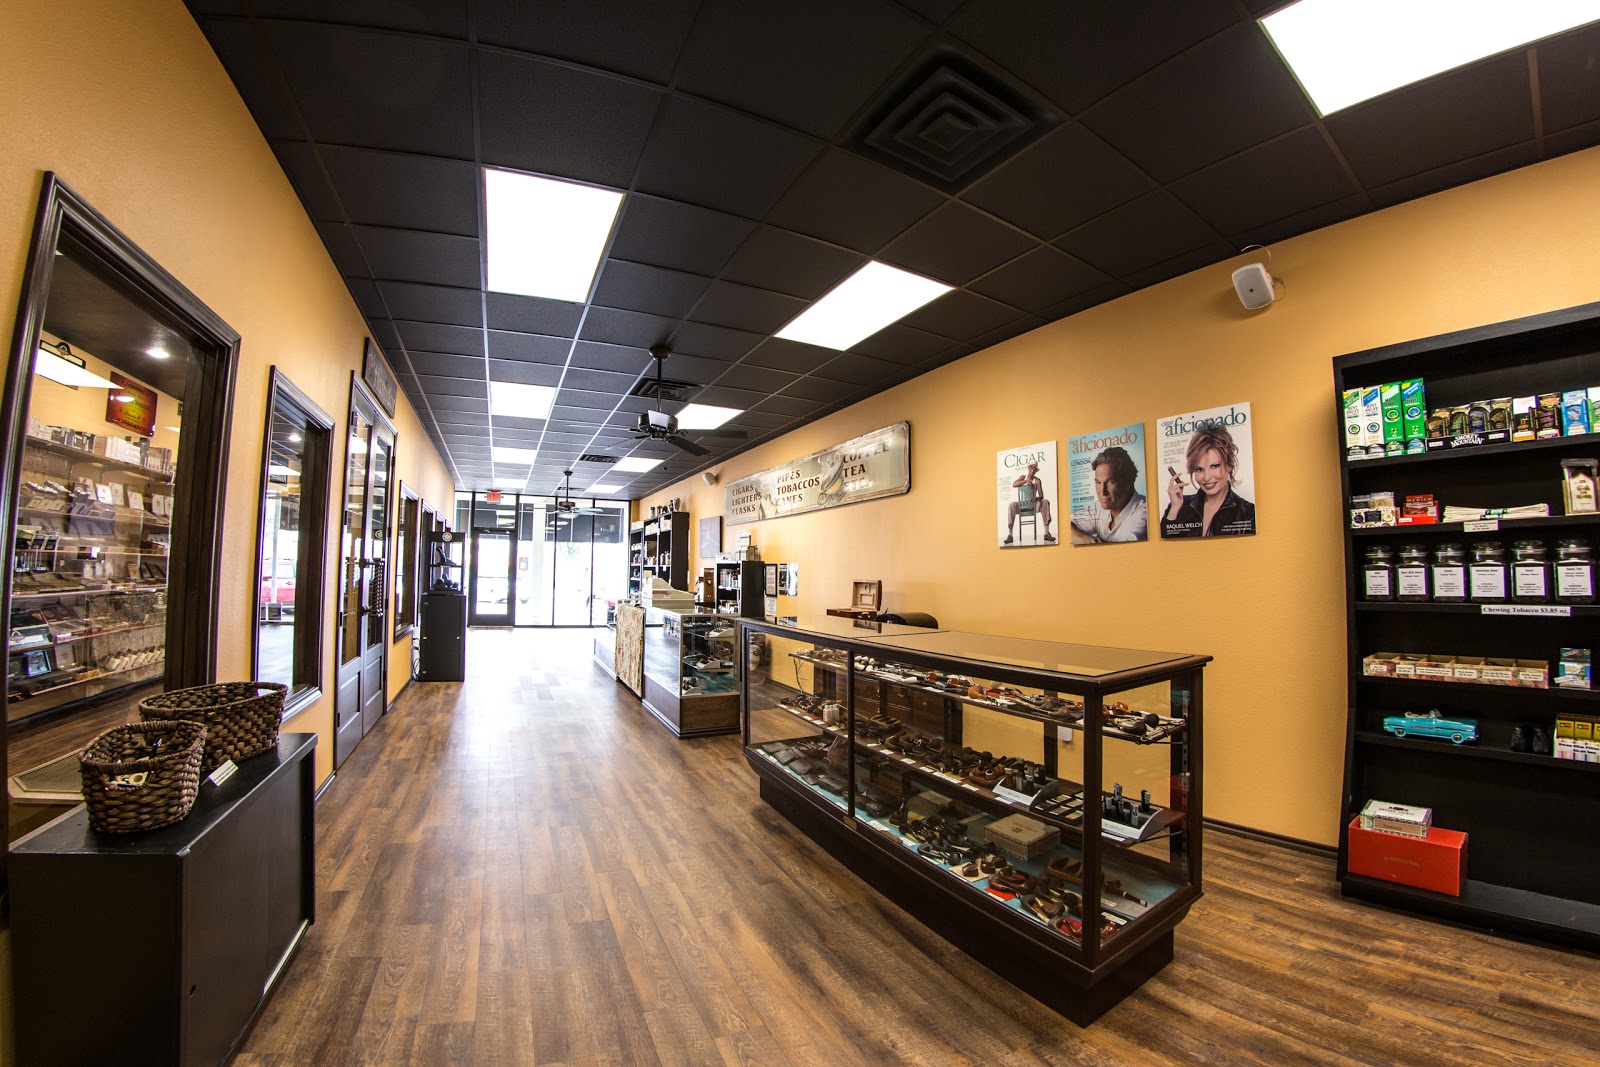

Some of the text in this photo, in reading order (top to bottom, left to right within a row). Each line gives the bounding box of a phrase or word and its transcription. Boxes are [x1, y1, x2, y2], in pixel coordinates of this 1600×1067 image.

[1165, 407, 1247, 437] aficionado
[1072, 428, 1138, 454] aficionado
[843, 441, 890, 463] COFEE
[1004, 451, 1046, 468] CIGAR
[843, 463, 866, 478] TEA
[1071, 459, 1091, 467] LONDON
[777, 469, 801, 484] PIPES
[732, 484, 754, 497] CIGARS
[777, 476, 820, 496] TOBACCOS
[731, 493, 762, 507] LIGHTERS
[732, 503, 756, 516] FLASKS
[1483, 606, 1511, 614] Chewing
